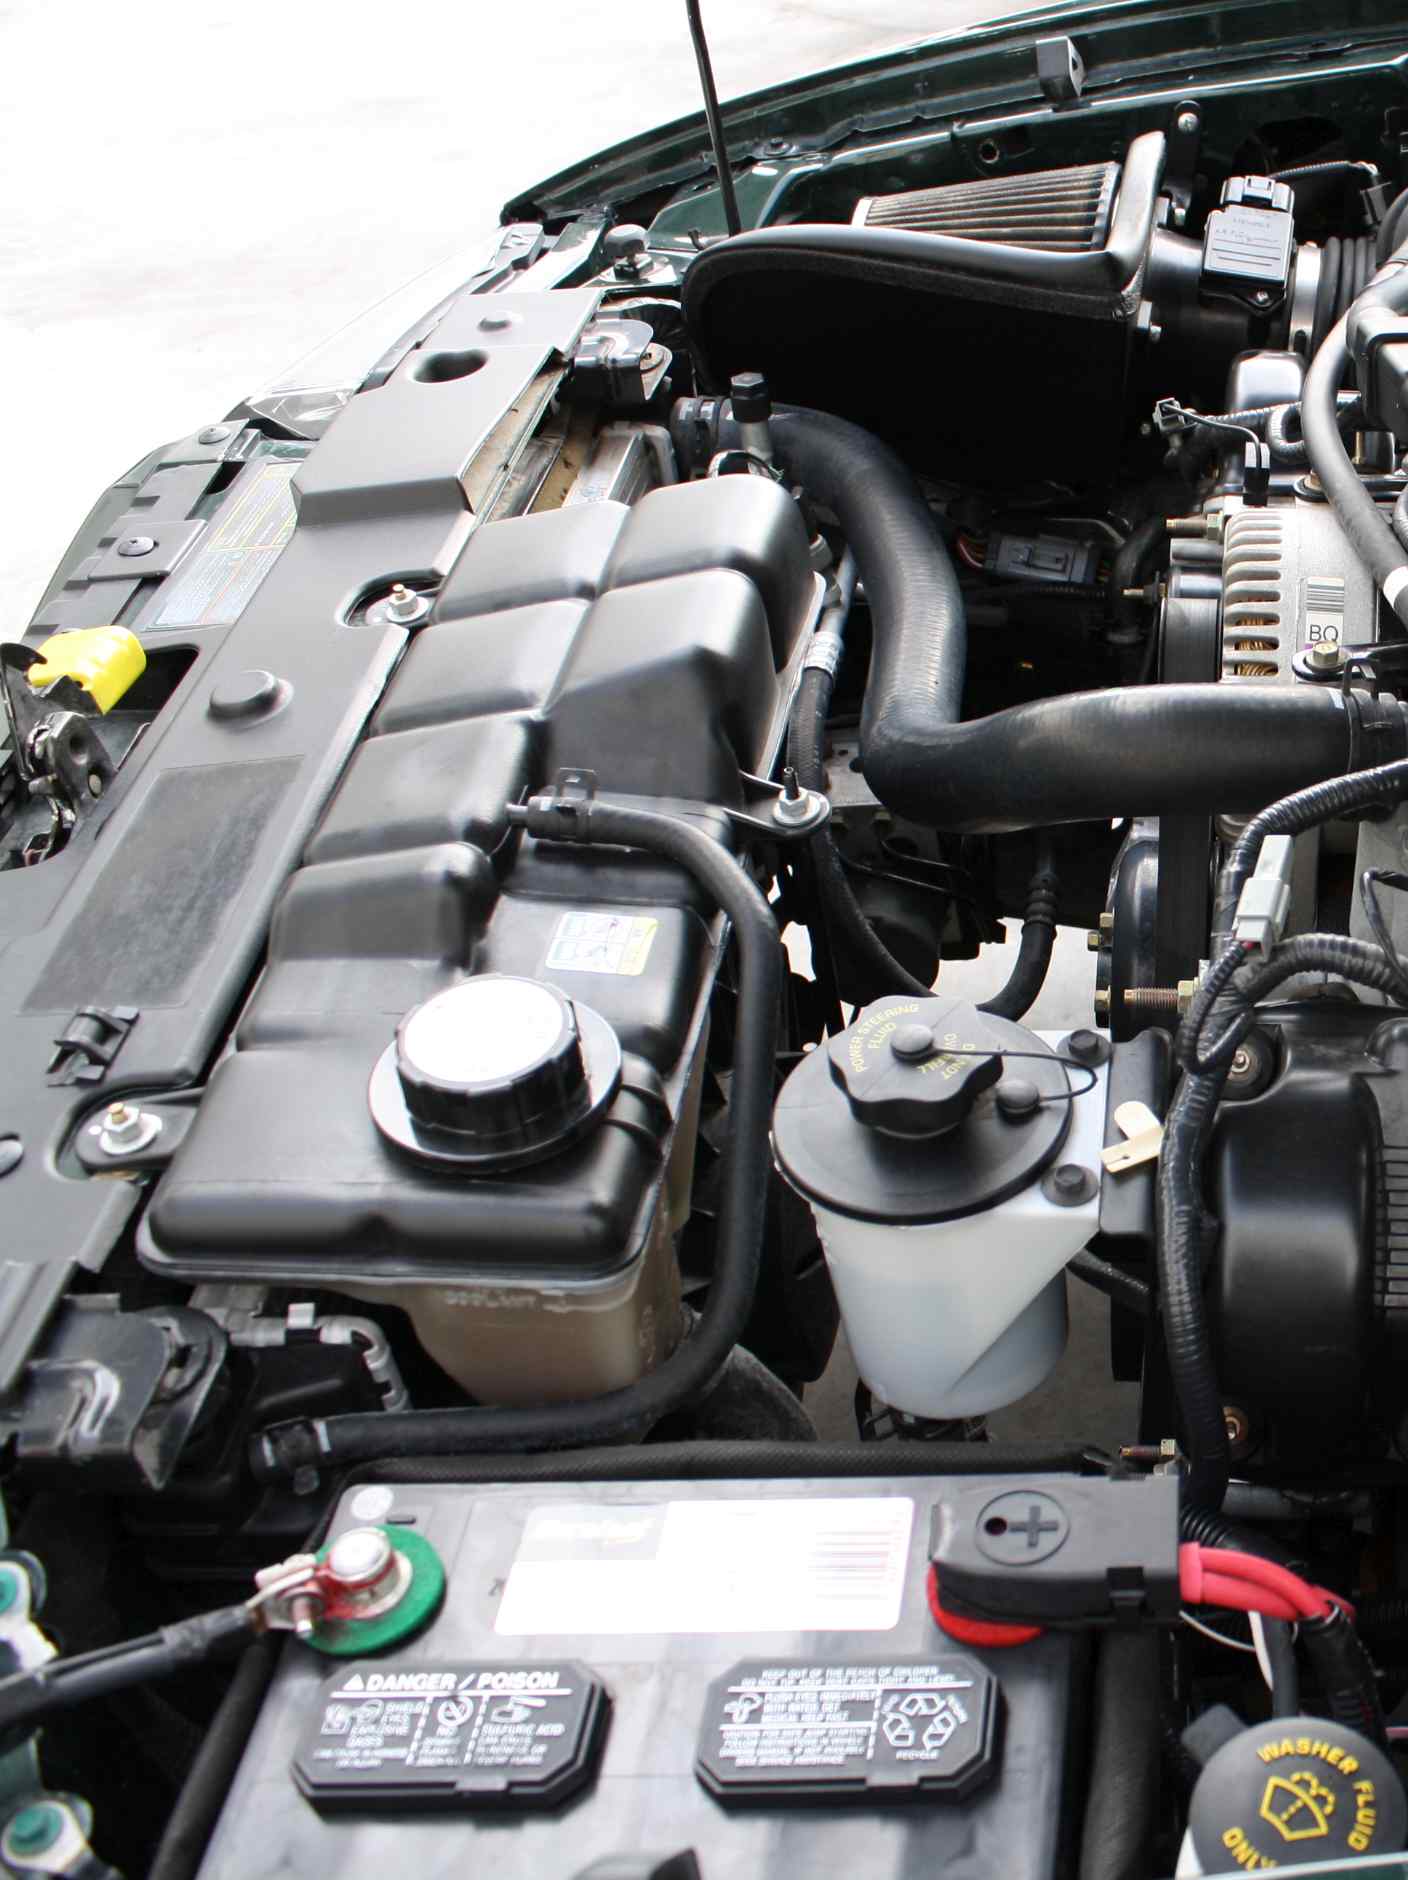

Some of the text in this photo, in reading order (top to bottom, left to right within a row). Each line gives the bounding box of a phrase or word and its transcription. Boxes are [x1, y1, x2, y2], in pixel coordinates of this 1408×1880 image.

[1309, 624, 1338, 641] BQ
[849, 1003, 920, 1073] POWER STEERING
[868, 1022, 897, 1049] FLUID
[366, 1673, 457, 1691] DANGER
[477, 1672, 560, 1690] POISON
[1256, 1736, 1377, 1852] WASHER FLUID
